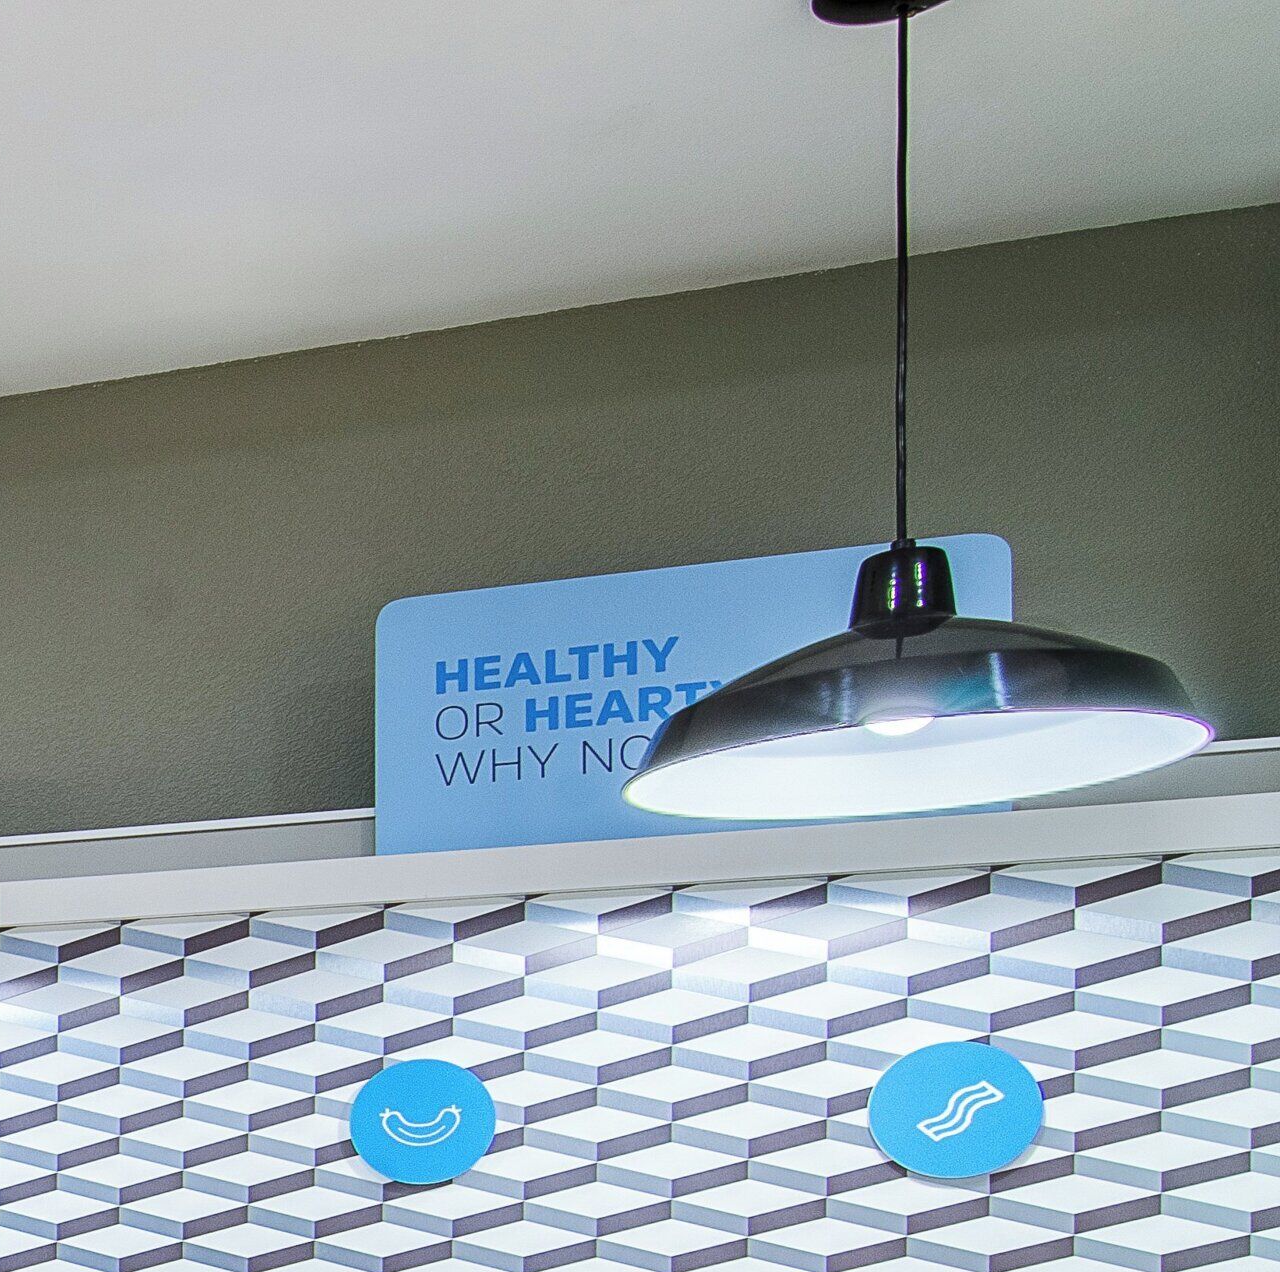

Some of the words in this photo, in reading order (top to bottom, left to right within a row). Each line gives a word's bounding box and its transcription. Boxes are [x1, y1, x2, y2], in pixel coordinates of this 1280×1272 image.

[435, 636, 681, 695] HEALTHY
[435, 702, 505, 741] OR
[525, 680, 723, 733] HEART
[435, 742, 559, 787] WHY
